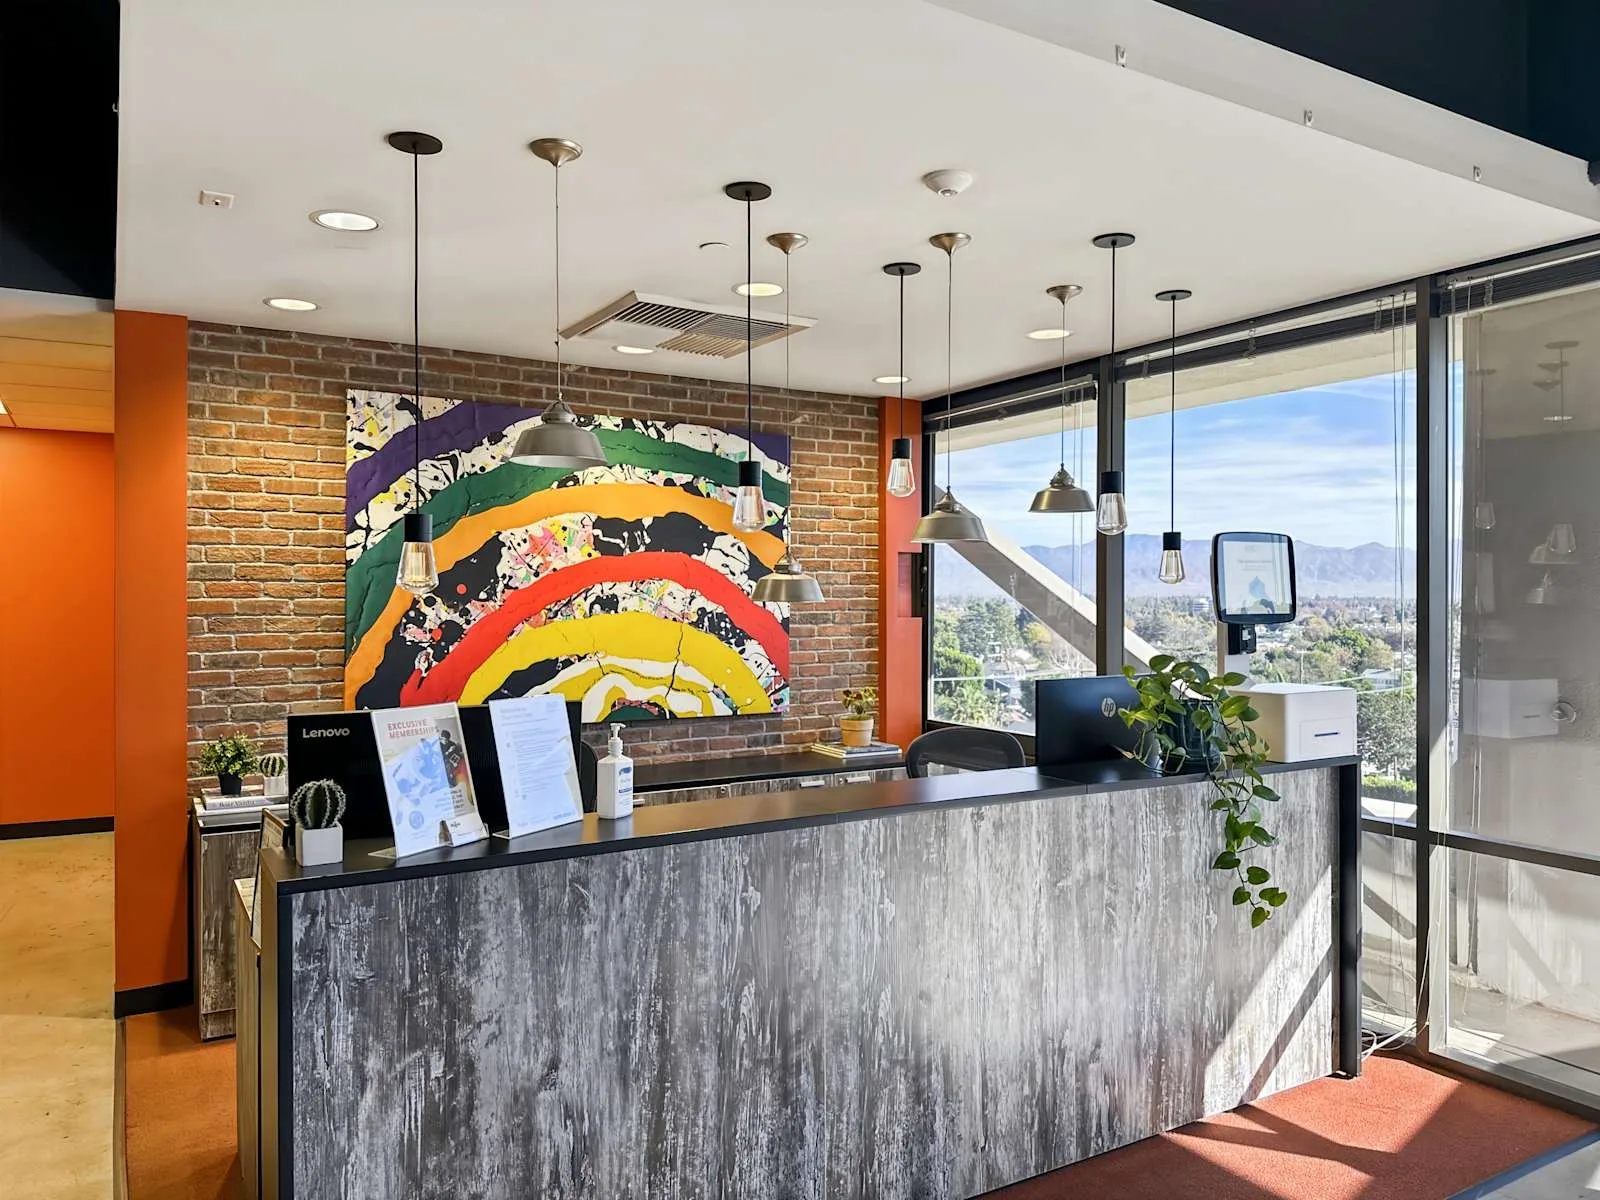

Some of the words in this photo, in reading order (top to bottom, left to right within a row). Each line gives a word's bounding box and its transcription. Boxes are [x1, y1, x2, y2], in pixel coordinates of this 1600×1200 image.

[1102, 698, 1116, 718] hp
[388, 720, 427, 731] EXCLUSIVE
[302, 728, 350, 739] Lenovo
